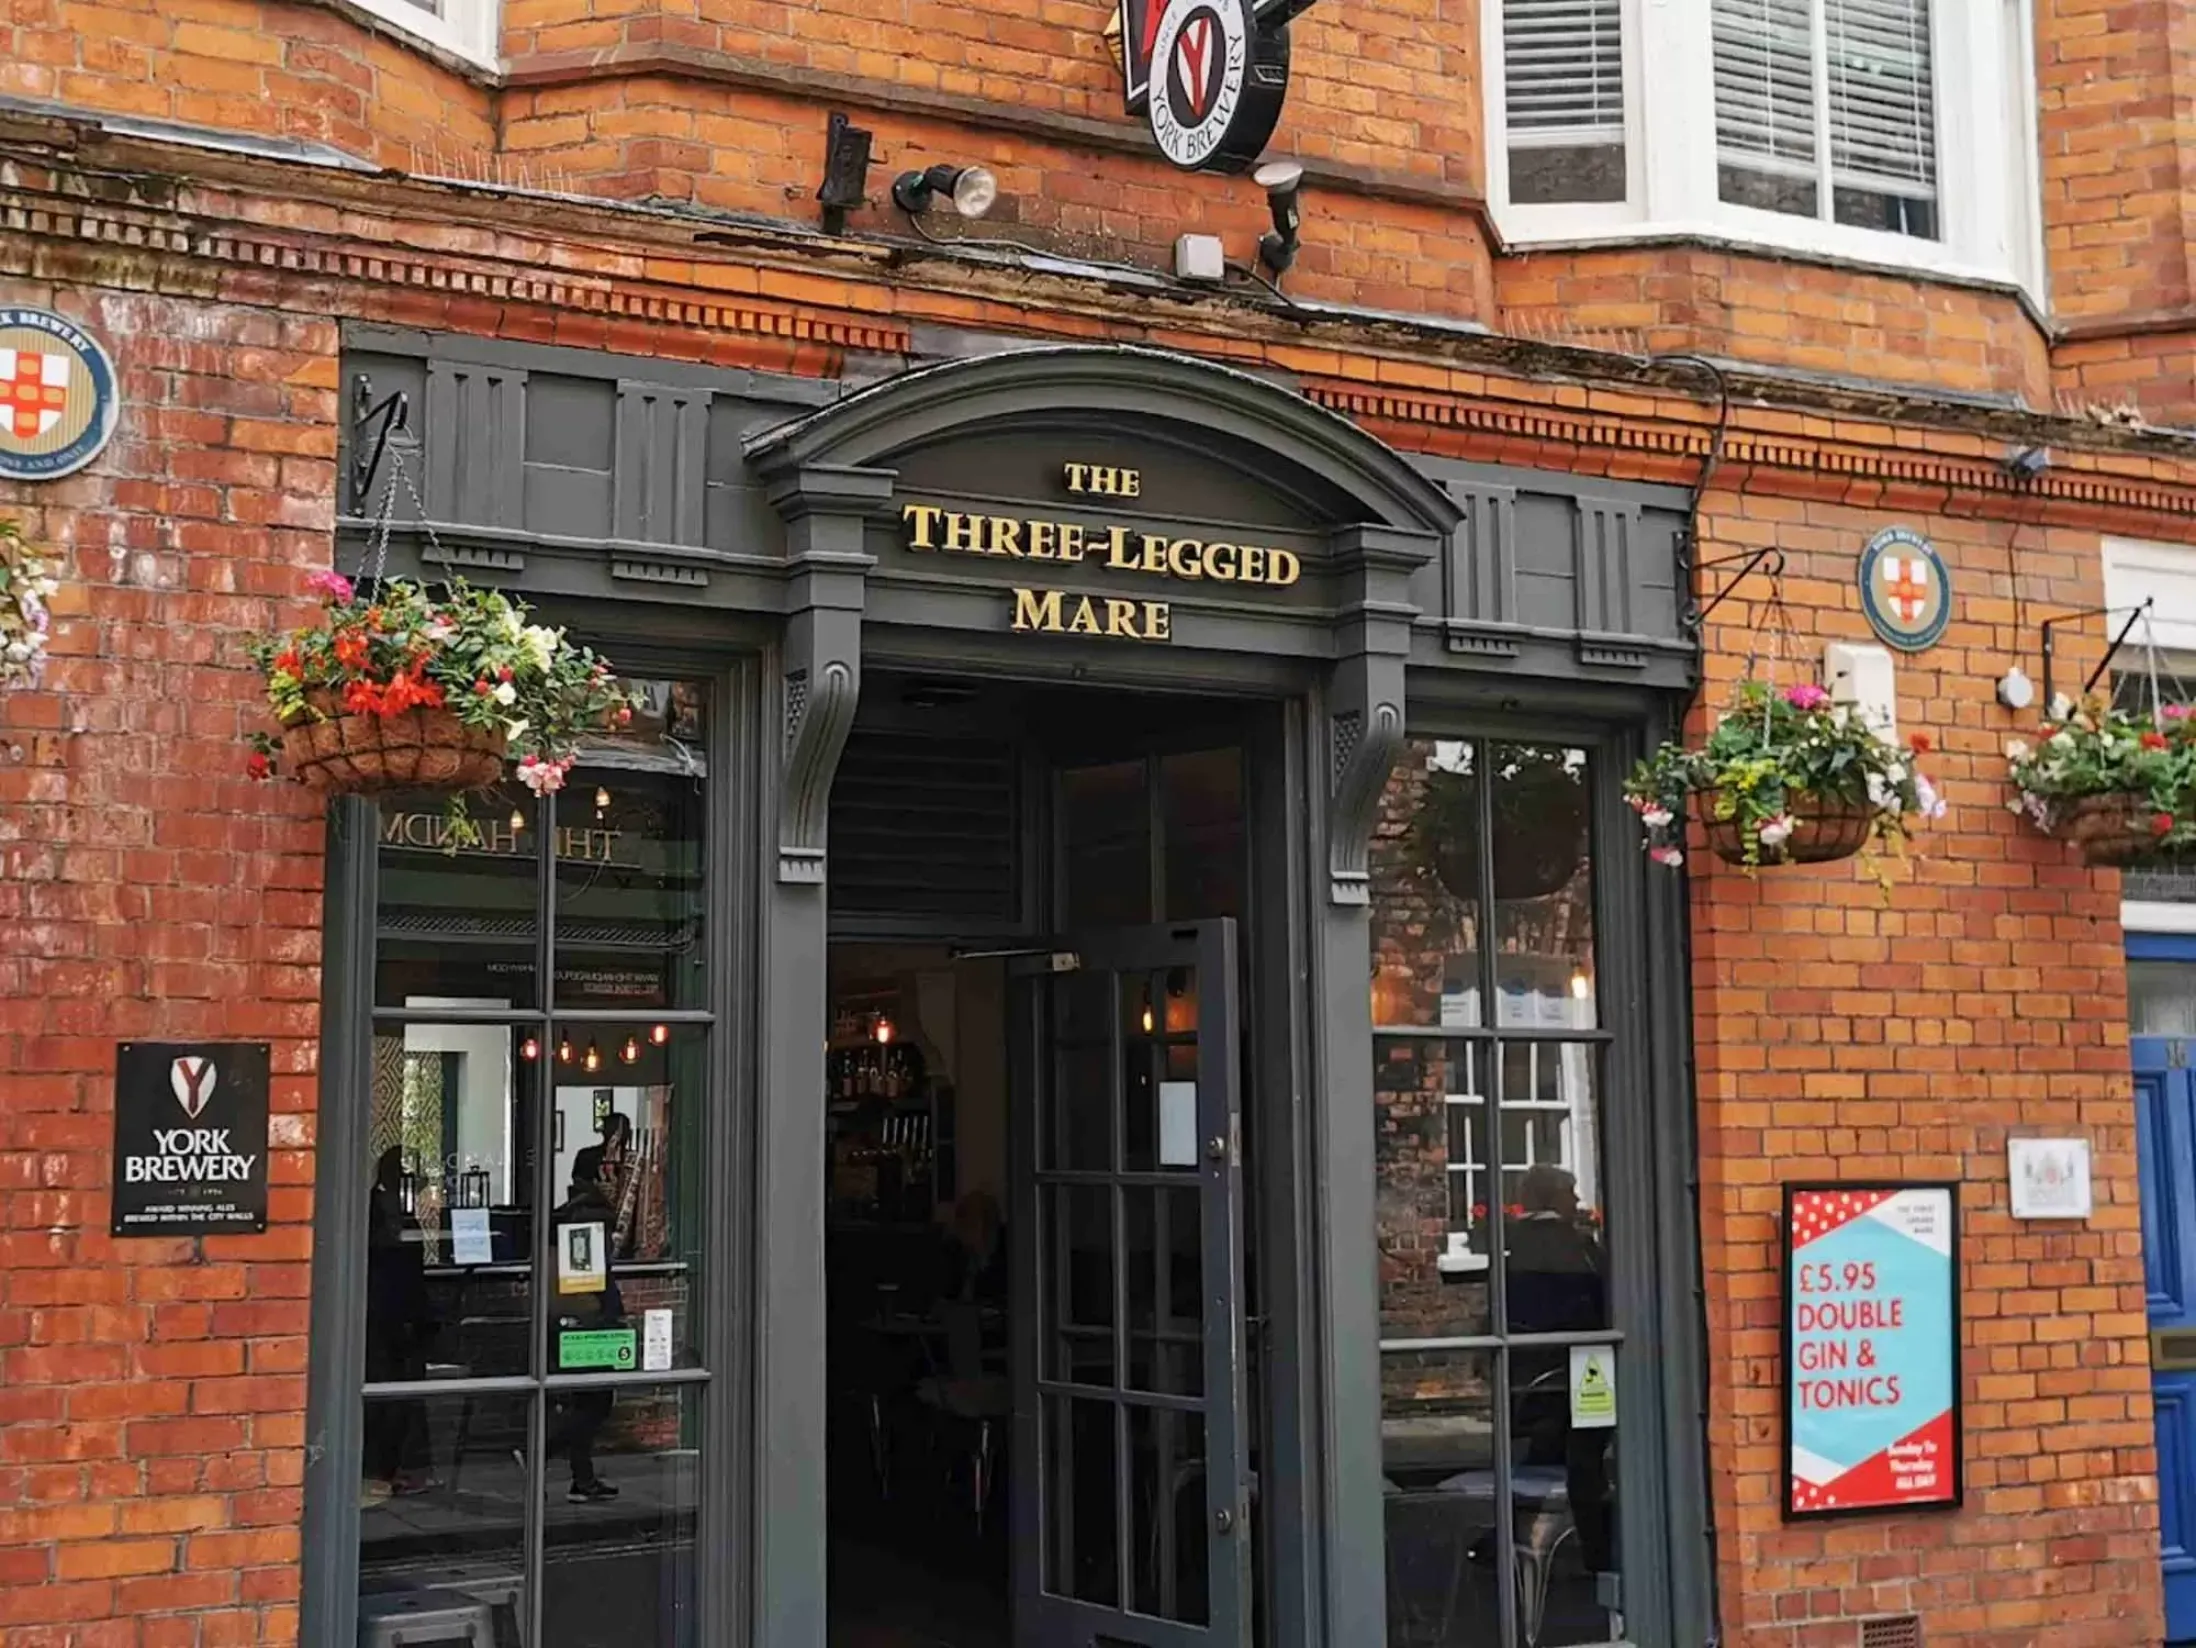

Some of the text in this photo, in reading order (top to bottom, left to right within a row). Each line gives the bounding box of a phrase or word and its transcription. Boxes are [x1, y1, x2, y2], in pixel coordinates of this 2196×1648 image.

[1153, 35, 1243, 159] YORK BREWERY
[19, 312, 90, 351] BREWERY
[1063, 463, 1141, 497] THE
[903, 504, 1301, 586] THREE-LEGGED
[1011, 588, 1170, 640] MARE
[153, 1128, 232, 1155] YORK
[125, 1154, 256, 1183] BREWERY
[190, 1213, 205, 1222] THE
[207, 1212, 225, 1221] CITY
[215, 1203, 236, 1212] ALES
[1799, 1262, 1876, 1293] £5.95
[1797, 1299, 1904, 1332] DOUBLE
[1798, 1338, 1876, 1371] GIN &
[1797, 1375, 1901, 1410] TONICS
